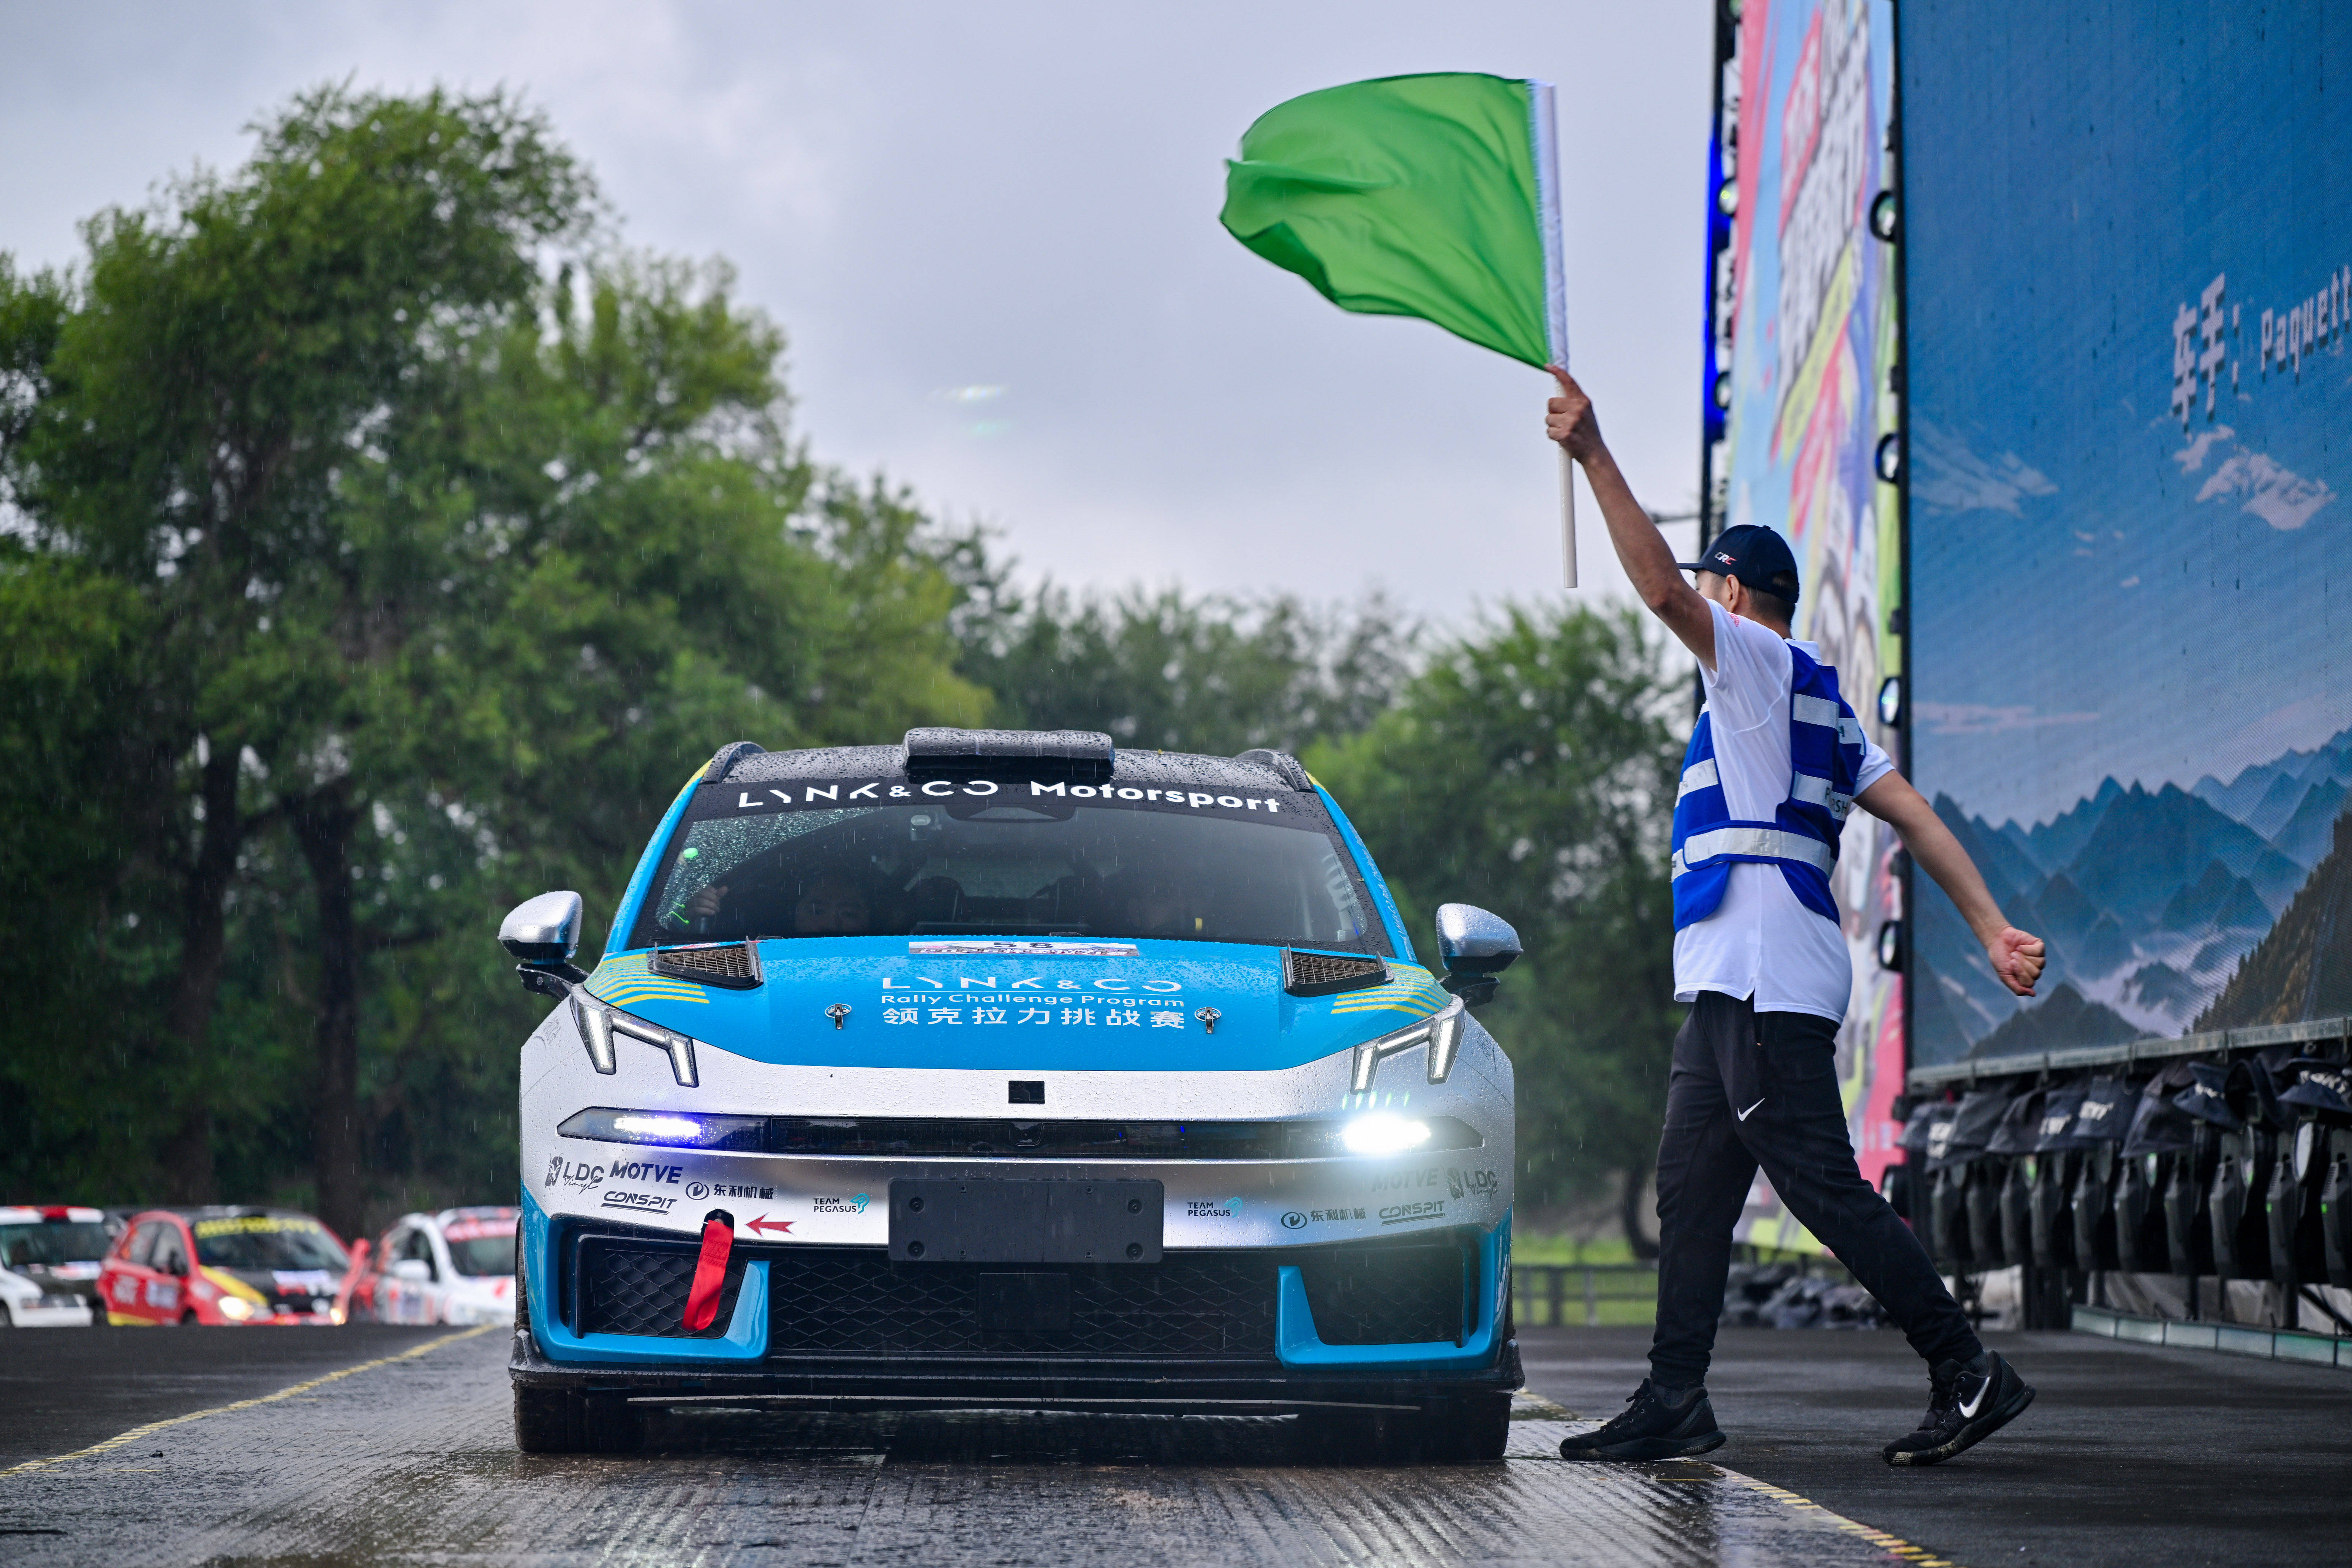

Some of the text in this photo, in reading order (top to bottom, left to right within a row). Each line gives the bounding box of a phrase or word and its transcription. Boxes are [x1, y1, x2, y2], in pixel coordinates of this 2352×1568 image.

[1031, 781, 1280, 813] Motorsport
[881, 993, 1184, 1007] Rally Challenge Program
[882, 1007, 1185, 1029] 领克拉力挑战赛
[562, 1161, 605, 1183] LDC
[609, 1160, 683, 1184] MOTVE
[1371, 1168, 1438, 1192] MOTVE
[604, 1190, 679, 1209] CONSPIT
[713, 1183, 774, 1200] 东利机械
[813, 1205, 857, 1213] PEGASUS
[1310, 1207, 1367, 1222] 东利机械
[1378, 1200, 1445, 1219] CONSPIT
